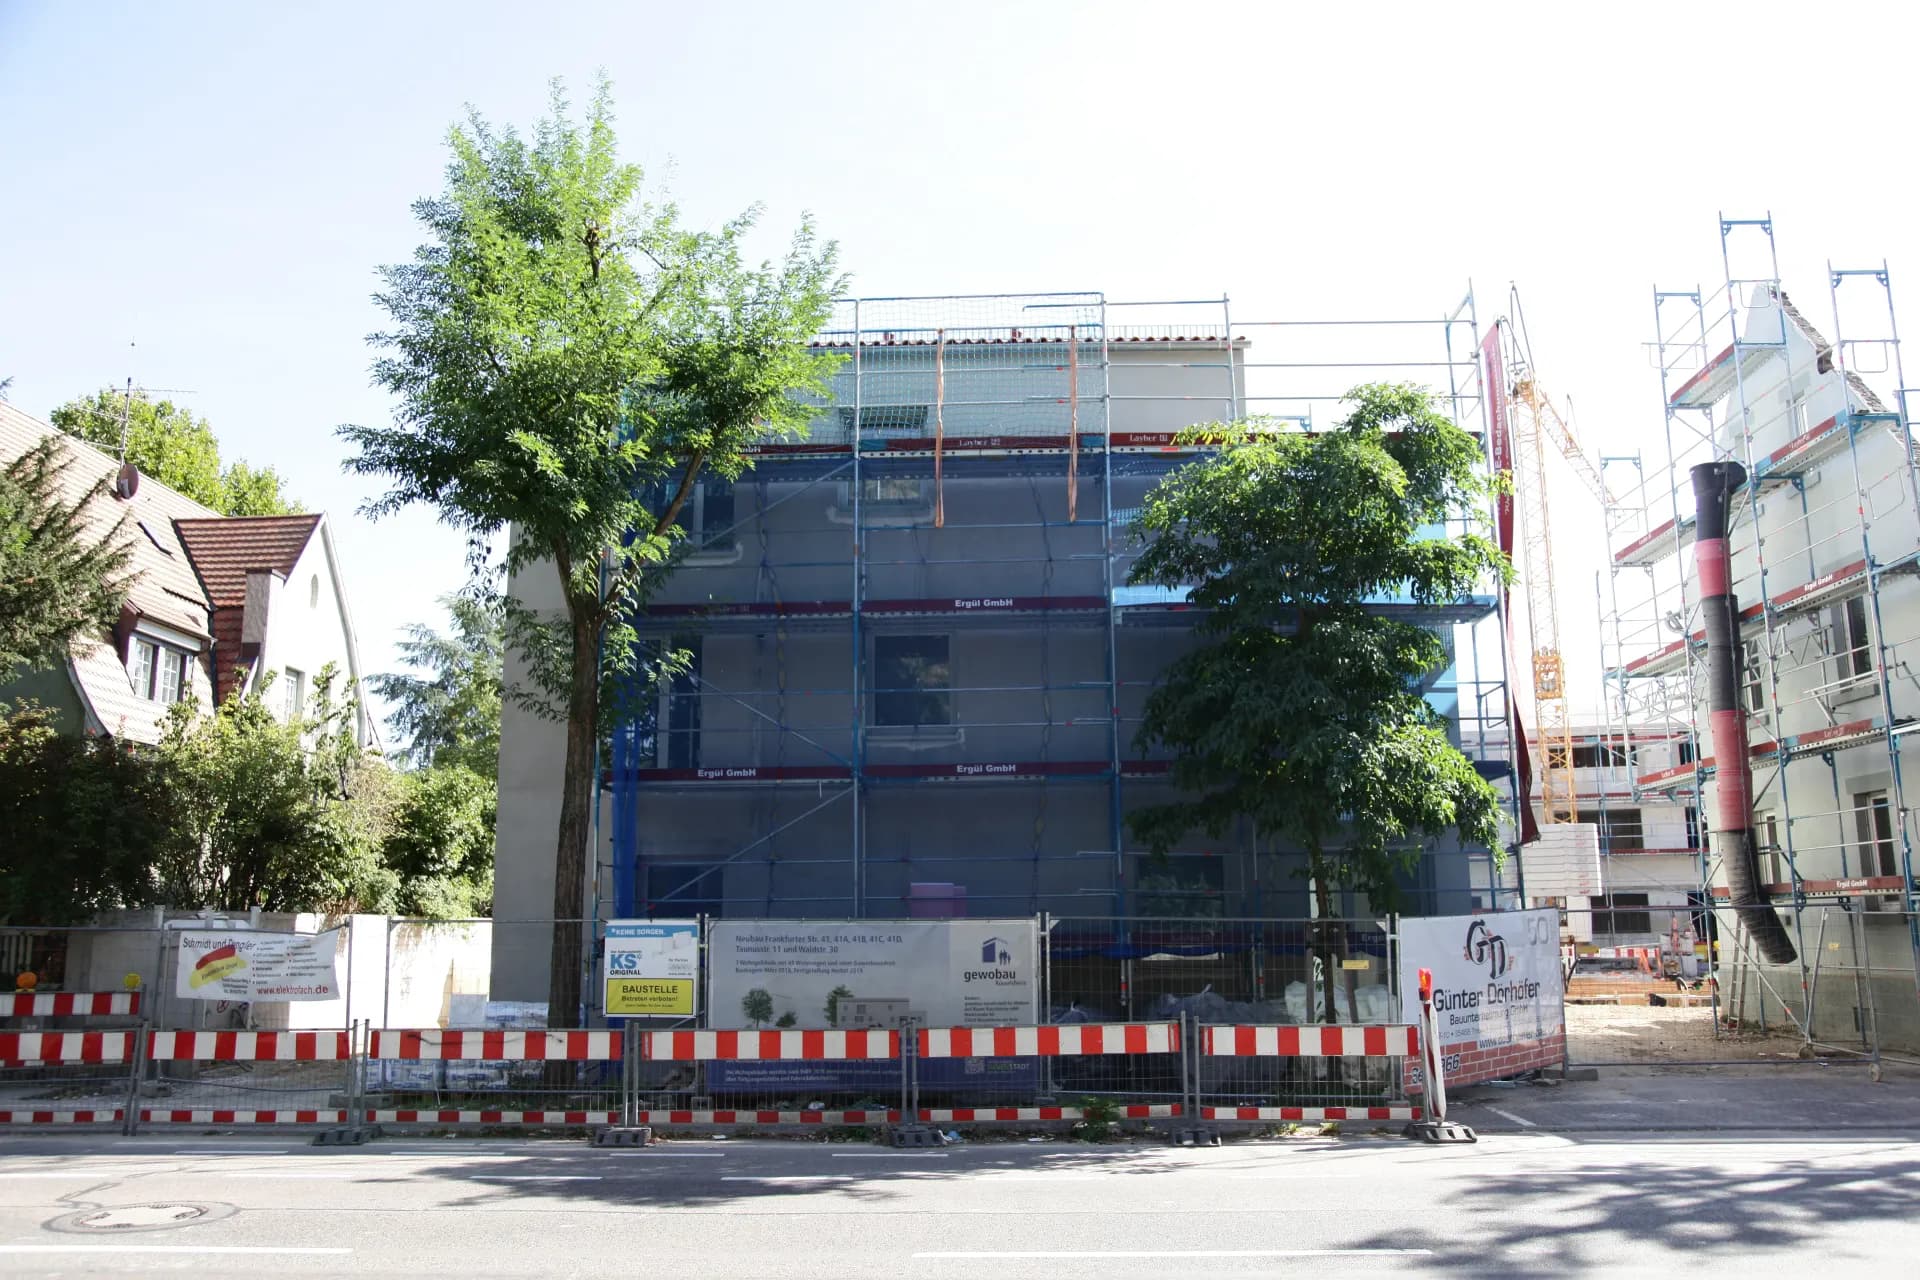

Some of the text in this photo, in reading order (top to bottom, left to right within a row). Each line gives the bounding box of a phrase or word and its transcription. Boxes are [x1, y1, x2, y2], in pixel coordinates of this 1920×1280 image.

[955, 599, 980, 608] Ergül
[697, 768, 756, 778] Ergül GmbH
[957, 764, 1016, 774] Ergül GmbH
[183, 937, 212, 949] Schmidt
[735, 935, 764, 943] Neubau
[765, 935, 806, 943] Frankfurter
[964, 969, 1016, 982] gewobau
[622, 985, 678, 994] BAUSTELLE
[1433, 978, 1541, 1012] Günter Dörhöfer
